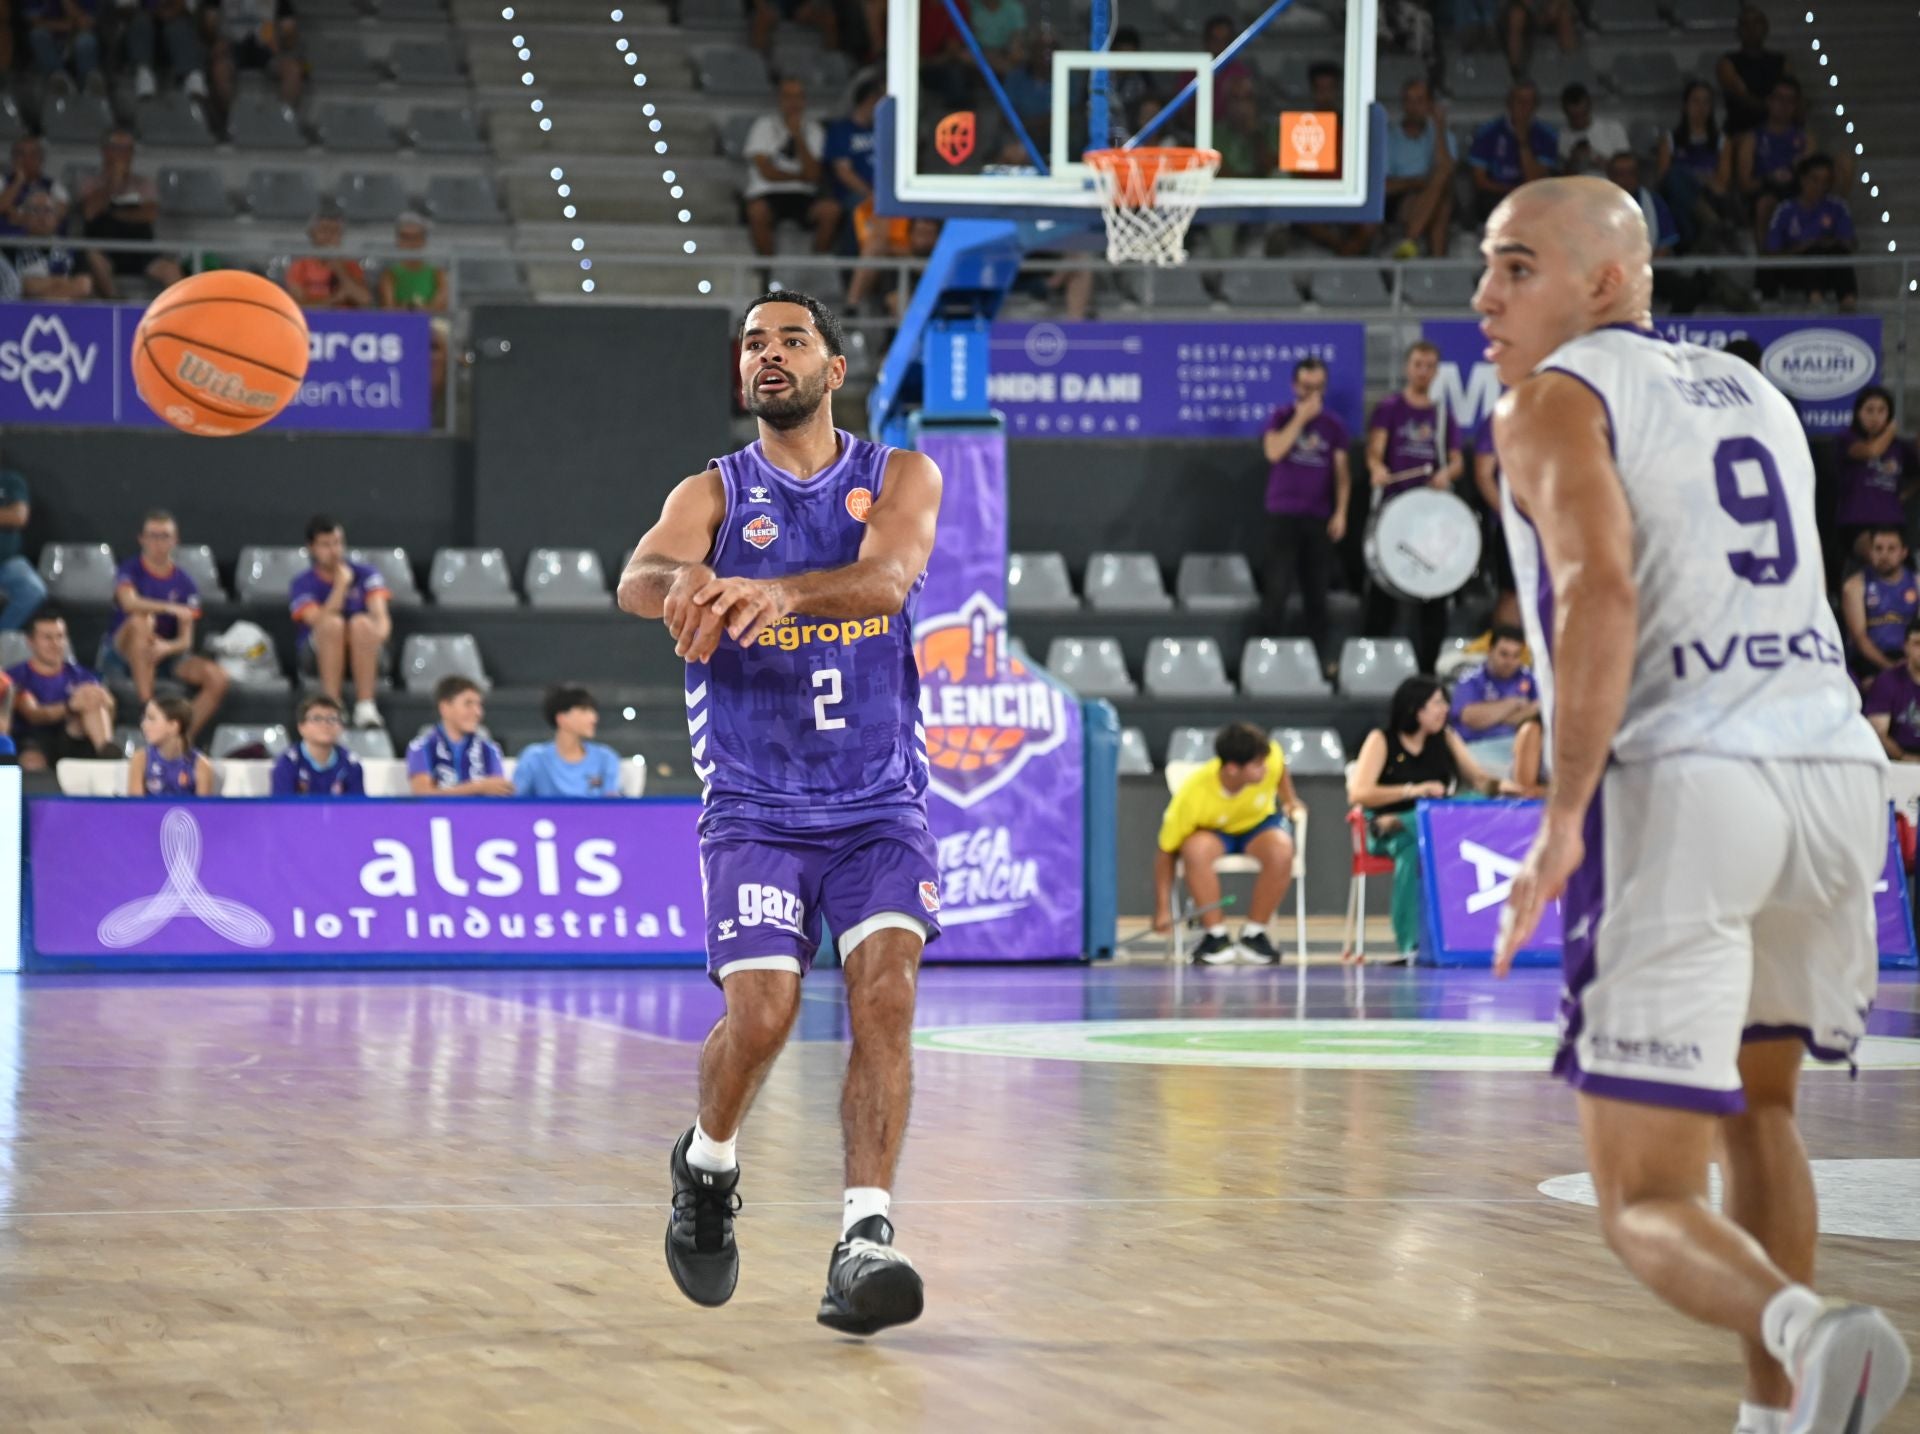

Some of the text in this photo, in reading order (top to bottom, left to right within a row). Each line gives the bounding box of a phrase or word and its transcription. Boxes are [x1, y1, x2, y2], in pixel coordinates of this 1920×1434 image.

[177, 351, 278, 410] Wilson
[1782, 356, 1854, 373] MAURI
[1713, 435, 1799, 586] 9
[758, 614, 890, 651] agropal
[769, 615, 798, 628] per
[811, 668, 847, 731] 2
[359, 816, 623, 898] alsis
[293, 904, 687, 940] IoT Industrial
